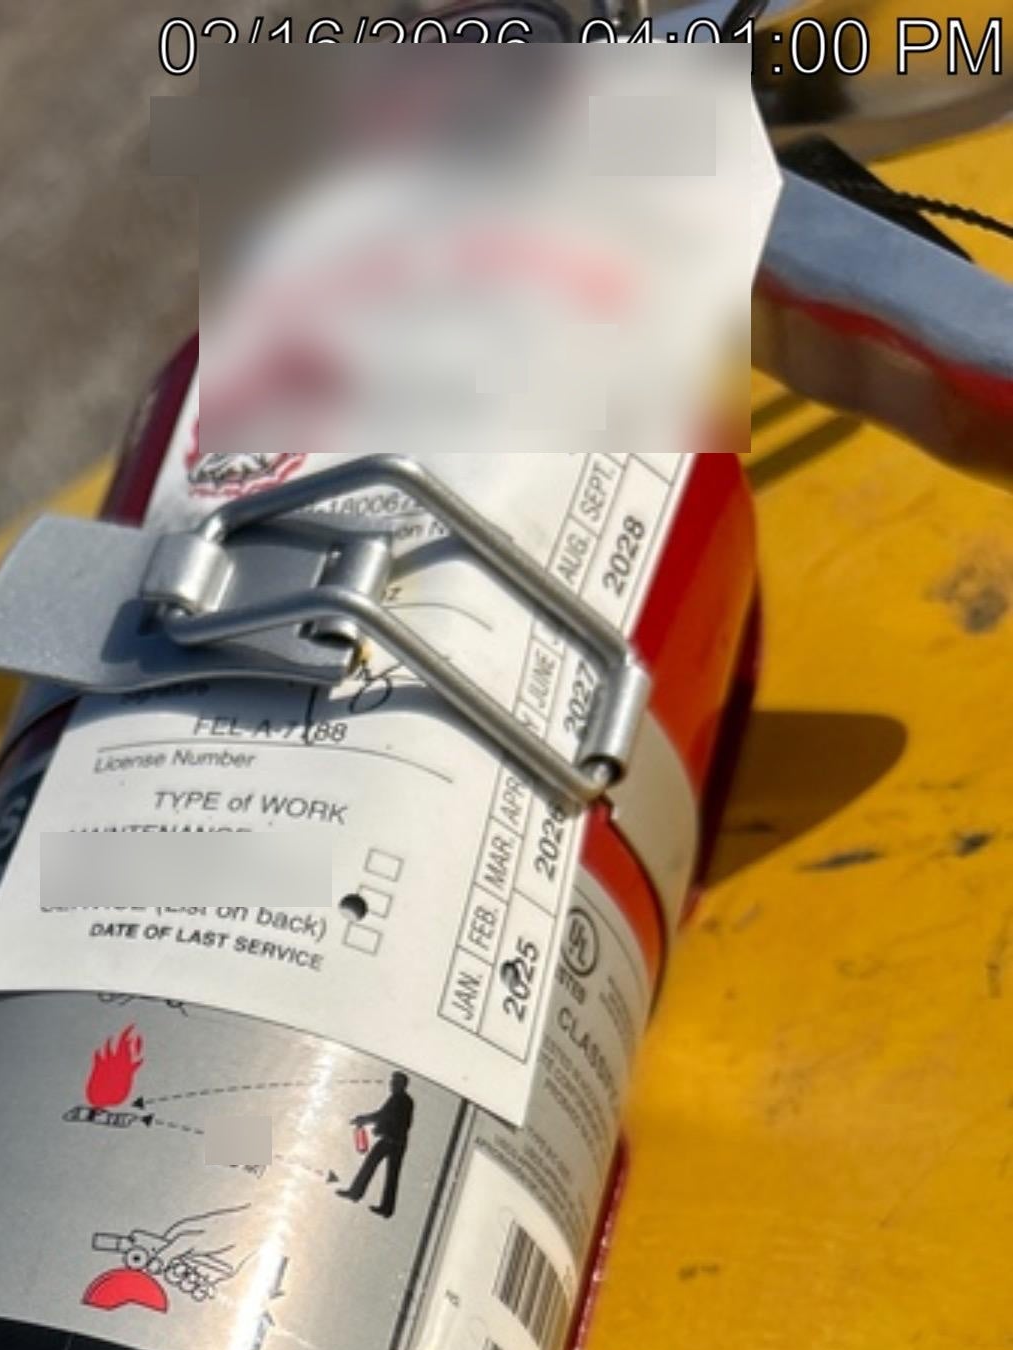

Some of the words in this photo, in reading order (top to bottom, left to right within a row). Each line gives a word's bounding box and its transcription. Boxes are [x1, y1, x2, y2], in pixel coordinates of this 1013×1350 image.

[602, 515, 645, 596] 2028
[563, 660, 595, 736] 2027
[94, 753, 166, 773] License
[172, 749, 257, 769] Number
[154, 790, 222, 813] TYPE
[228, 792, 253, 812] of
[261, 794, 350, 825] WORK
[88, 922, 140, 938] DATE
[143, 923, 172, 939] OF
[175, 926, 230, 949] LAST
[233, 936, 325, 972] SERVICE
[256, 907, 328, 943] back)
[467, 905, 499, 951] FEB.
[452, 971, 484, 1021] JAN.
[502, 937, 539, 1023] 2025
